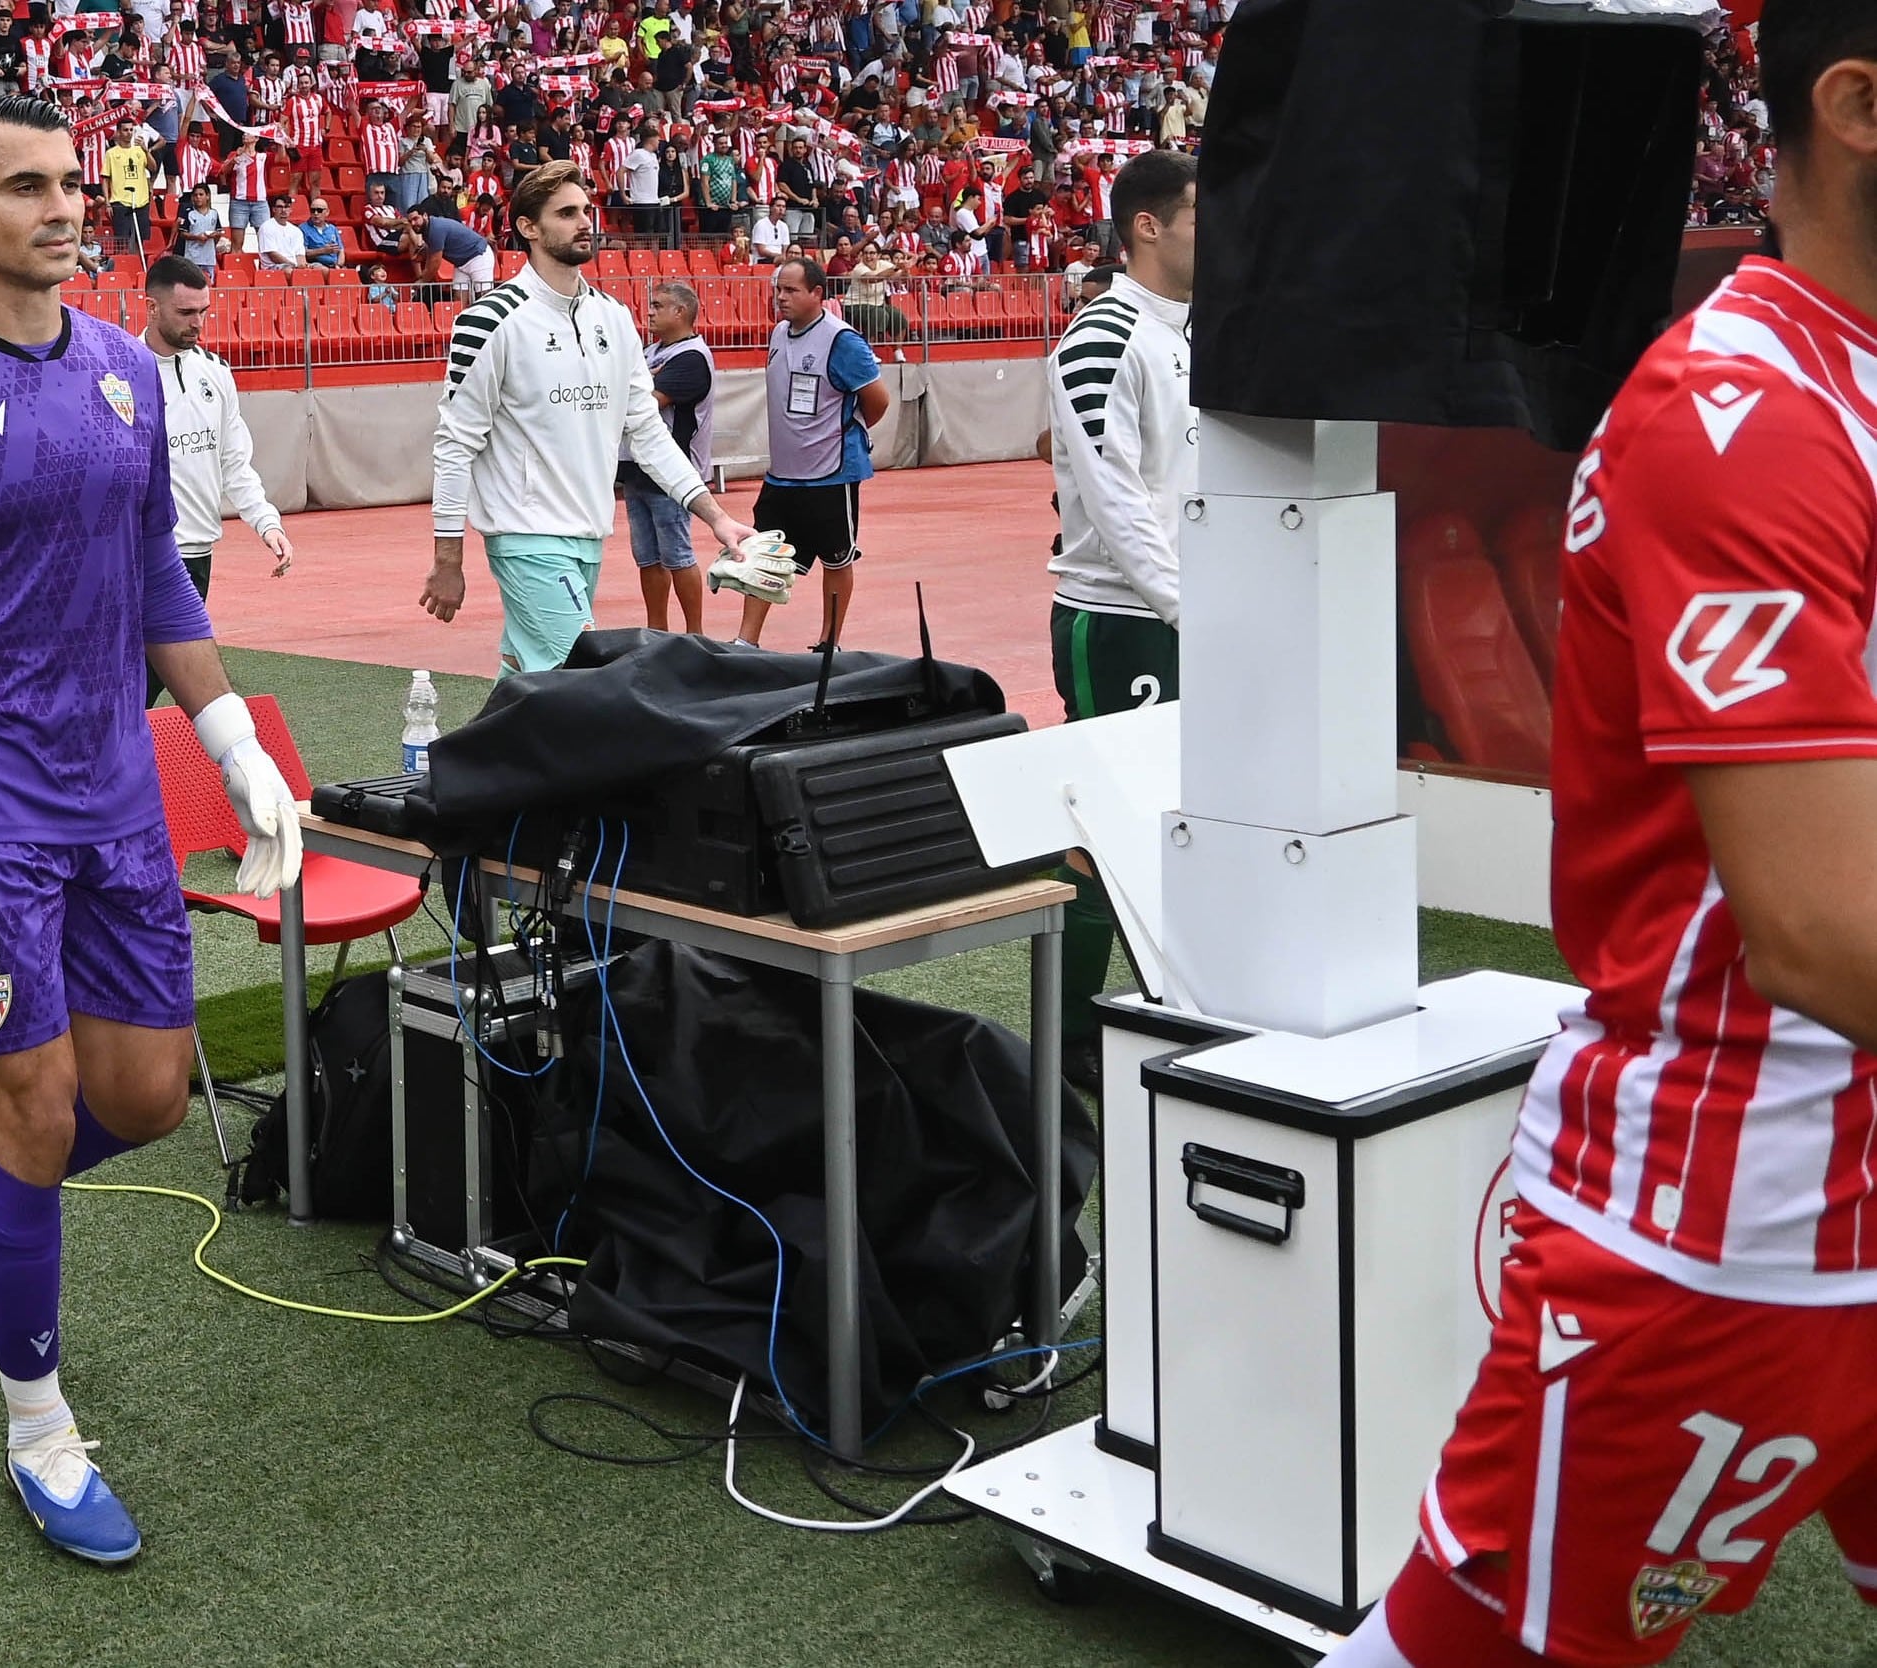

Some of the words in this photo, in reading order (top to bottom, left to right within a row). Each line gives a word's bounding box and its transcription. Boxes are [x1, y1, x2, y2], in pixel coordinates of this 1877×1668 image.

[558, 575, 583, 612] 1
[1130, 674, 1161, 705] 2
[1644, 1409, 1819, 1564] 12
